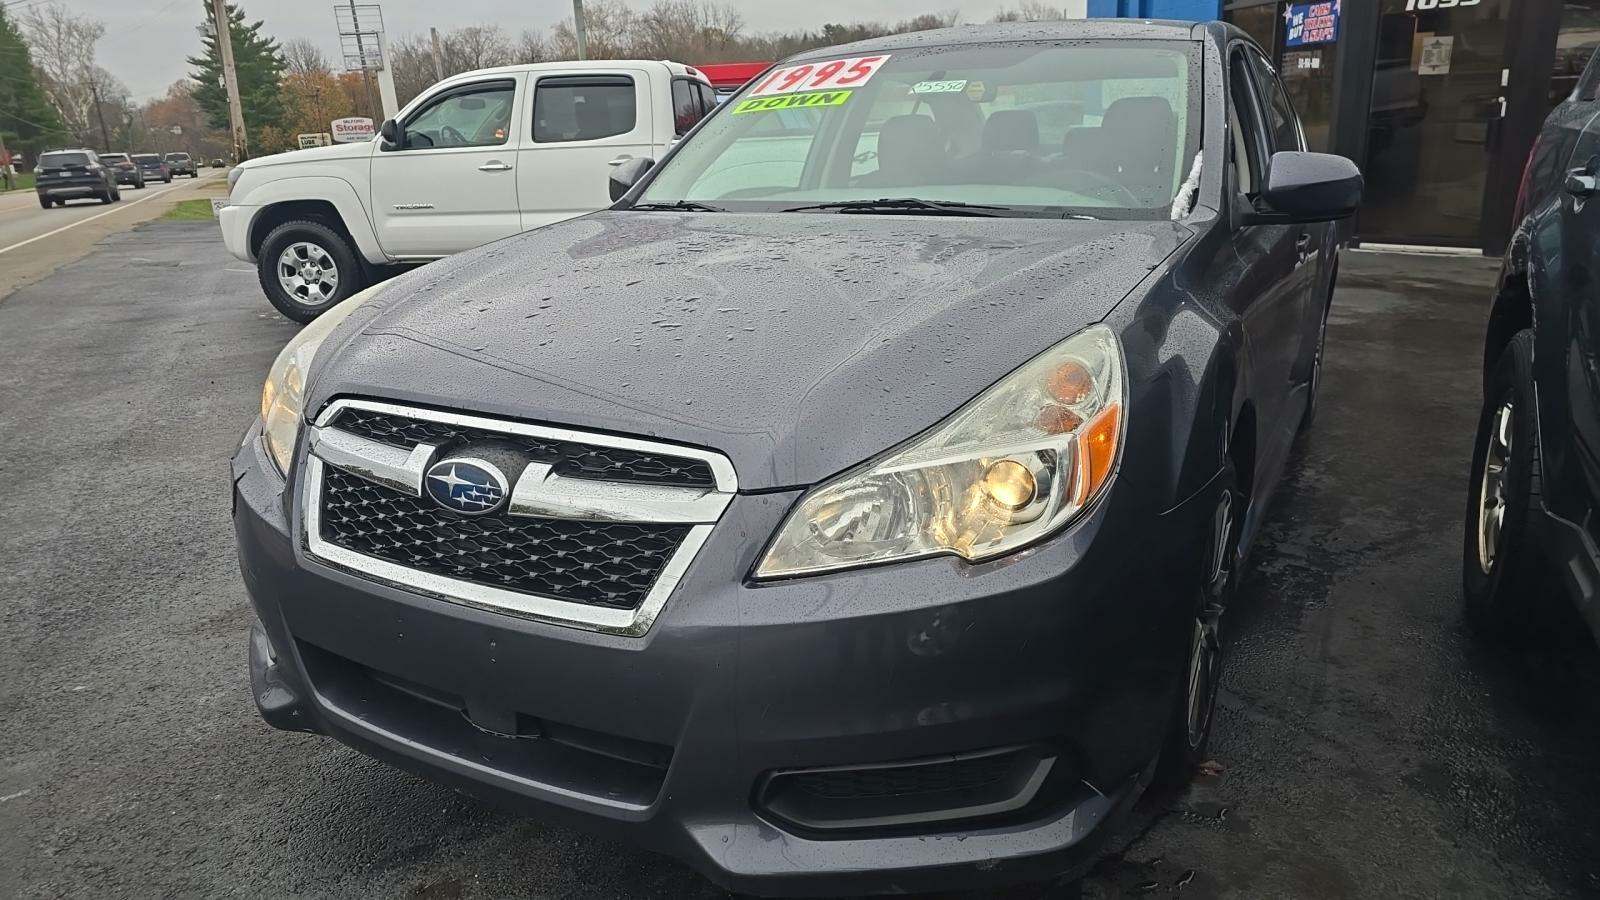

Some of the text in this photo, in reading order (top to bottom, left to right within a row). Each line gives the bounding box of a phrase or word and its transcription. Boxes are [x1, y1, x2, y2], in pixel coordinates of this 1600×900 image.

[1292, 12, 1304, 26] WE
[1288, 25, 1304, 40] BUY
[751, 56, 883, 95] 1995
[740, 92, 843, 111] DOWN
